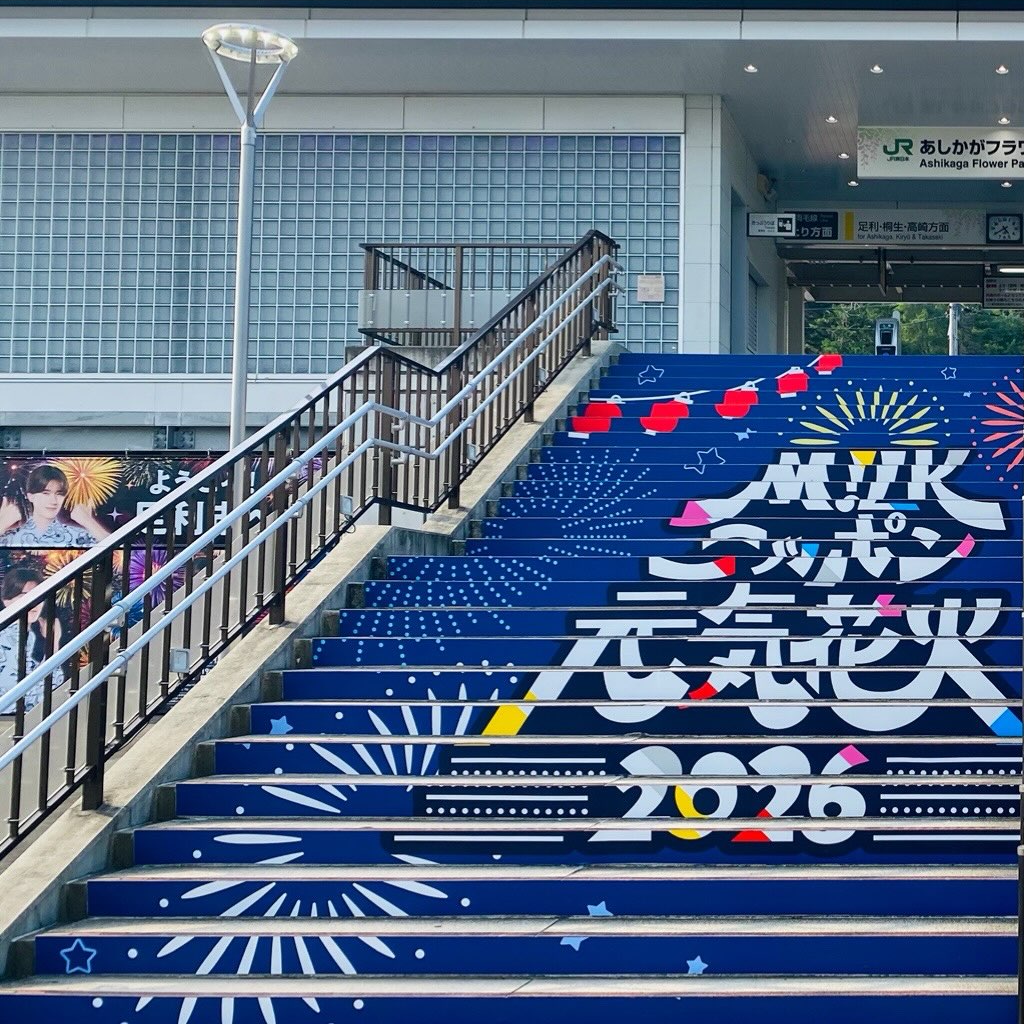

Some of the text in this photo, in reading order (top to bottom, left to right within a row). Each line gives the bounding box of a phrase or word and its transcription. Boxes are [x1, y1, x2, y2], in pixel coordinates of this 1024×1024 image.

[883, 138, 913, 155] JR
[920, 159, 969, 170] Ashikaga
[972, 159, 1009, 169] Flower
[857, 221, 949, 233] 足利・桐生・高崎方面
[648, 513, 975, 586] ニッポン
[482, 583, 1023, 737] 元気花火
[588, 745, 869, 844] 2026
